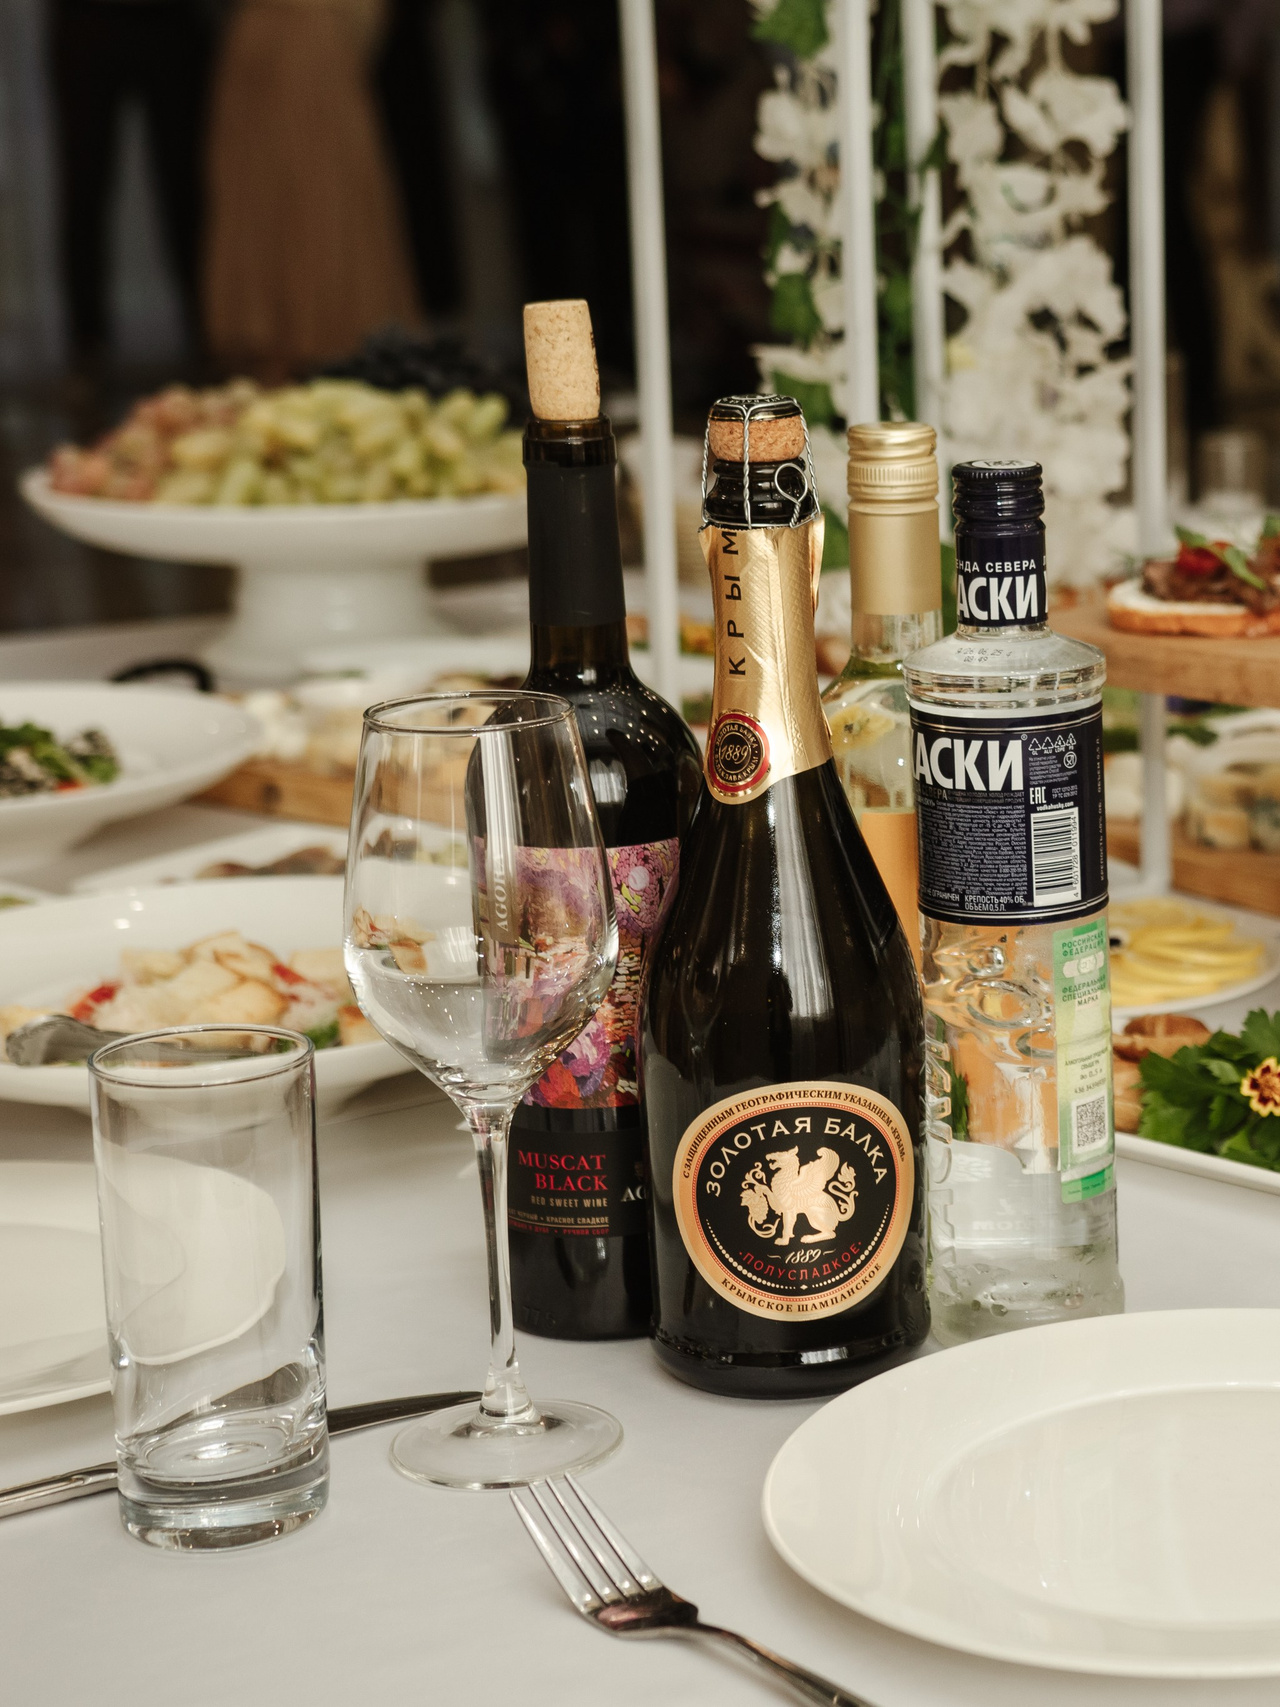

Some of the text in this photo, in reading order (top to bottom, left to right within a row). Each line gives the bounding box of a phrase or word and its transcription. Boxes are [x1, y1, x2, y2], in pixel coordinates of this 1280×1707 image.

[985, 559, 1036, 573] СЕВЕРА
[722, 531, 746, 676] КРЫМ
[958, 573, 1039, 620] АСКИ
[740, 727, 758, 748] БАЛКА
[721, 744, 748, 764] 1889
[913, 731, 1024, 791] АСКИ
[965, 895, 998, 904] КРЕПОСТЬ
[1077, 994, 1098, 1006] МАРКА
[683, 1089, 906, 1179] С ЗАЩИЩЕННЫМ ГЕОГРАФИЧЕСКИМ УКАЗАНИЕМ «КРЫМ»
[518, 1150, 606, 1171] MUSCAT
[706, 1116, 888, 1197] ЗОЛОТАЯ БАЛКА
[535, 1173, 608, 1192] BLACK
[531, 1195, 608, 1208] RED SWEET WINE
[546, 1216, 575, 1224] КРАСНОЕ
[577, 1216, 609, 1225] СЛАДКОЕ
[742, 1243, 860, 1281] ПОЛУСЛАДКОЕ
[784, 1248, 822, 1264] 1889
[721, 1263, 881, 1312] КРЫМСКОЕ ШАМПАНСКОЕ
